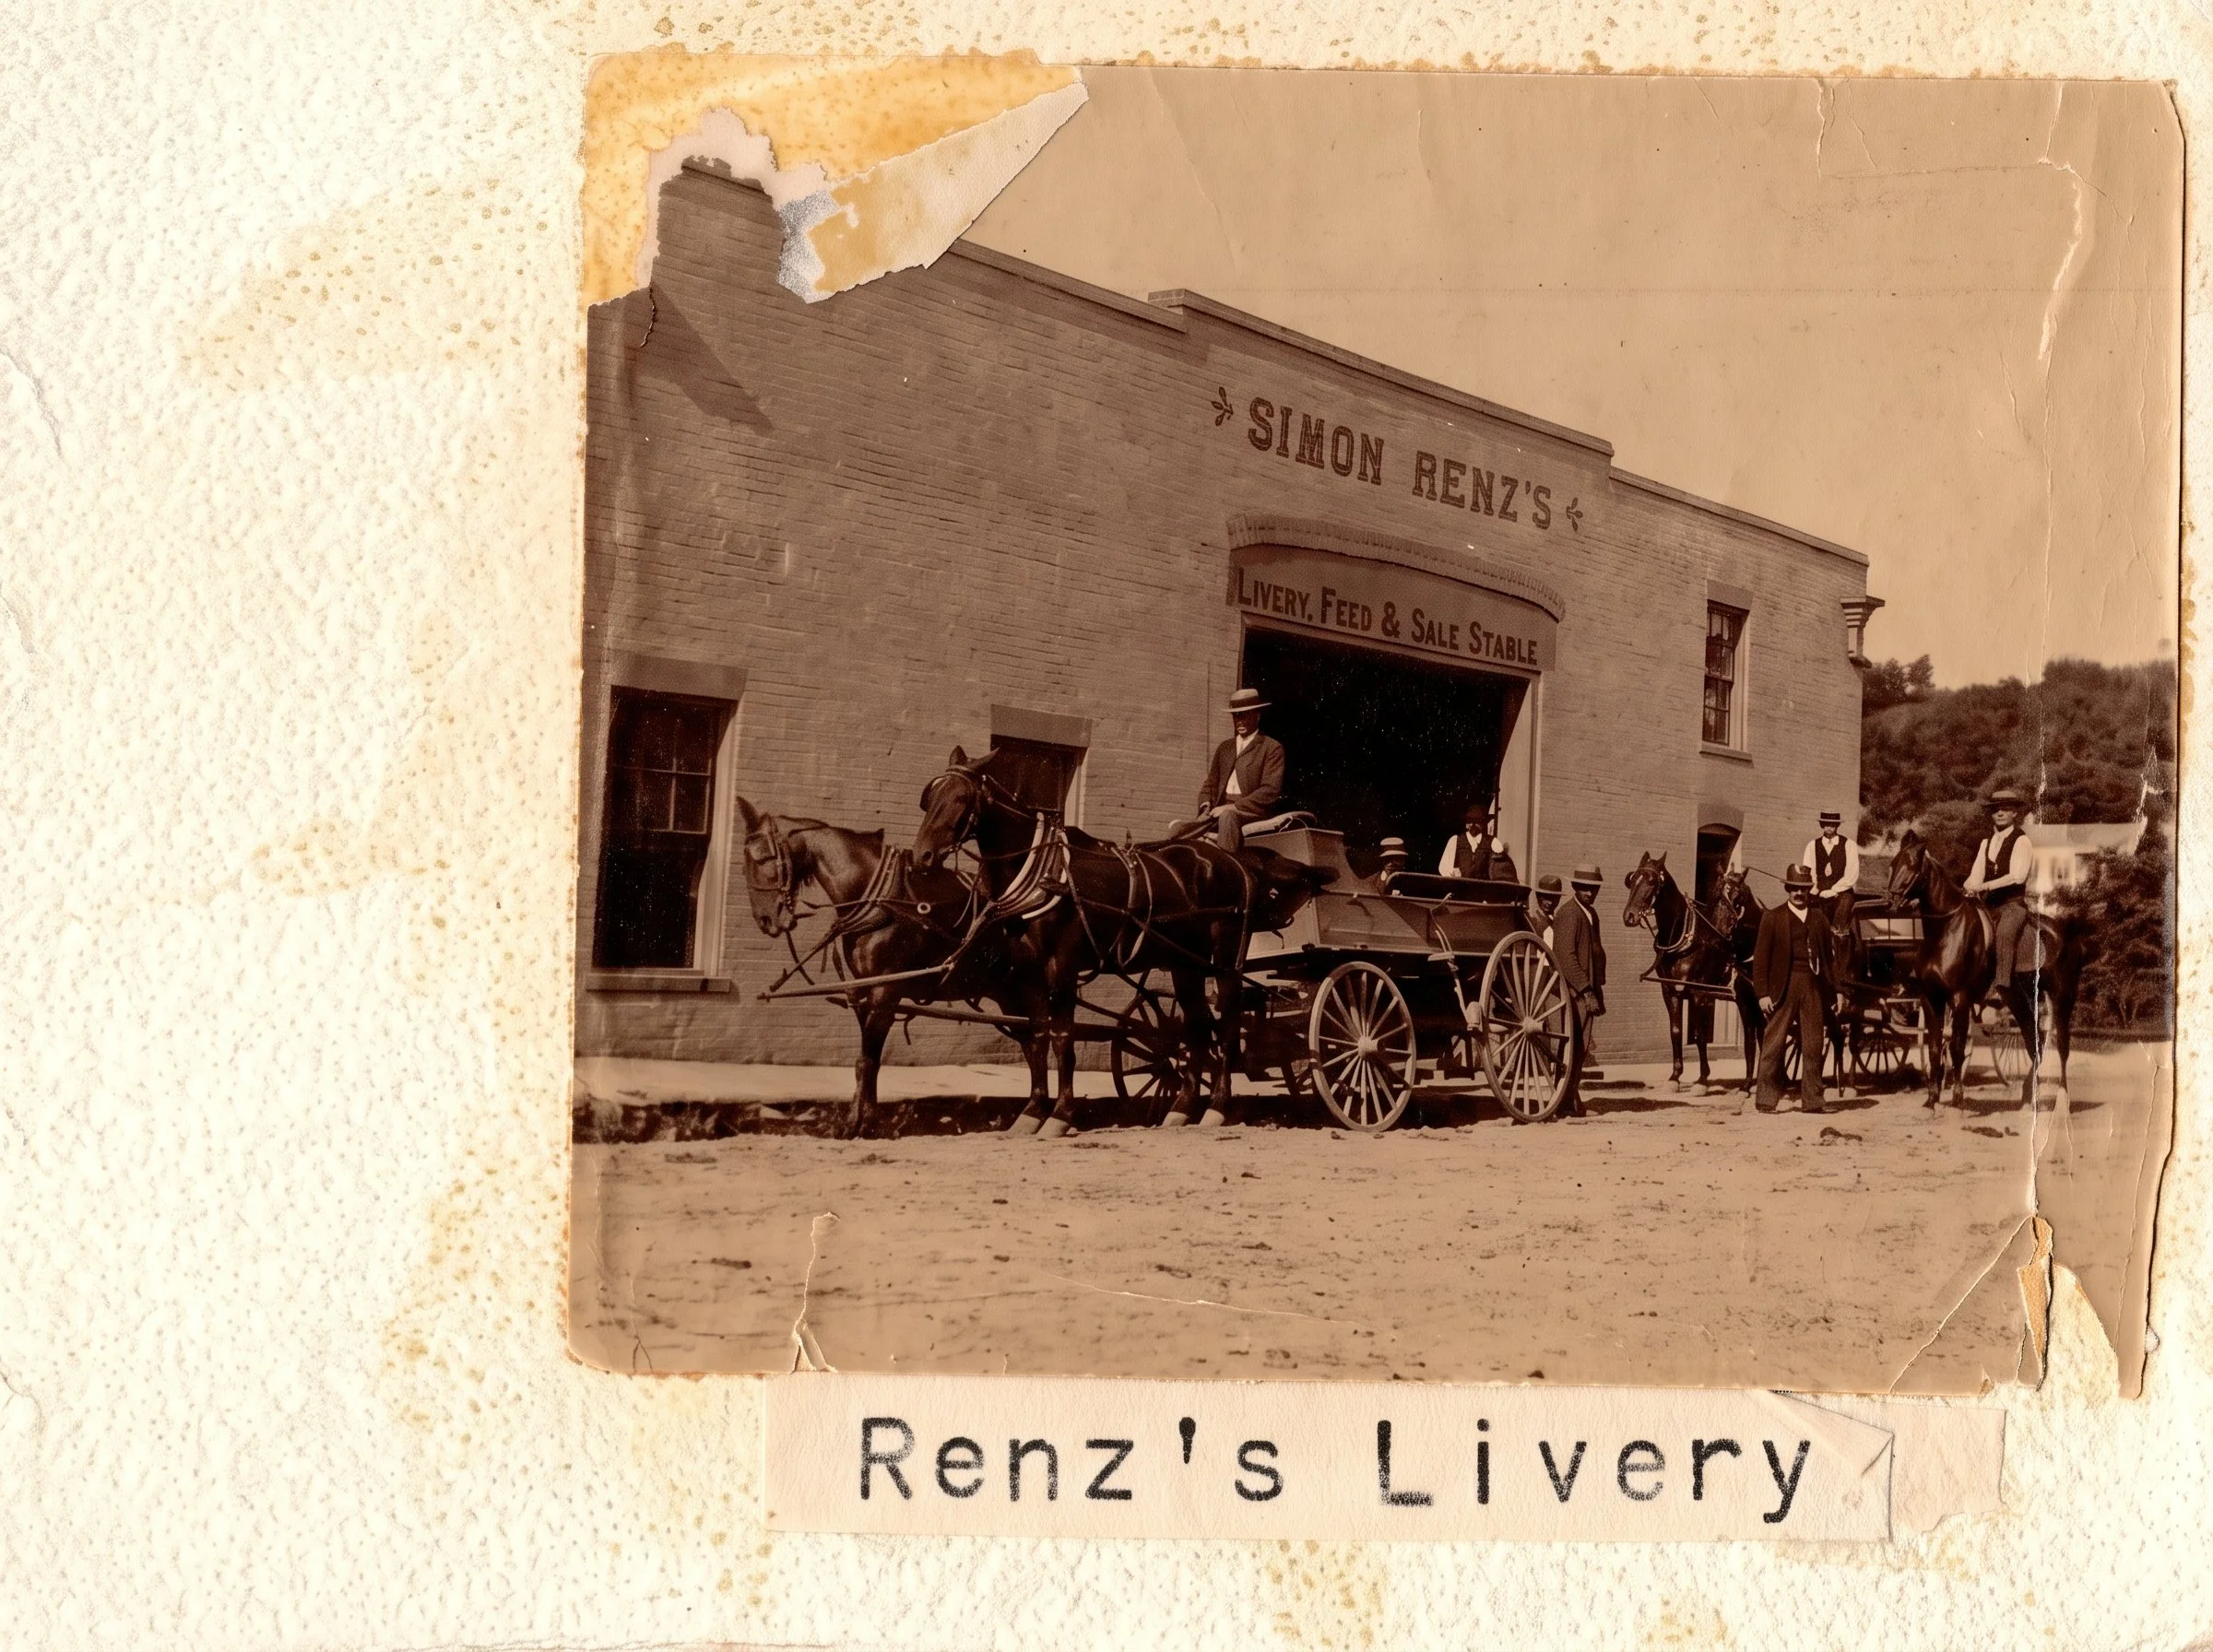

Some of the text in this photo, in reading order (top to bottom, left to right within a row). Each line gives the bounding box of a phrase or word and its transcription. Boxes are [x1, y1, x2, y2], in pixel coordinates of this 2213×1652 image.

[1248, 397, 1551, 530] SIMON RENZ'S
[1320, 585, 1372, 631] FEED
[1381, 600, 1401, 638] &
[1411, 608, 1460, 651] SALE
[1469, 621, 1538, 666] STABLE
[860, 1416, 1810, 1523] Renz's Livery
